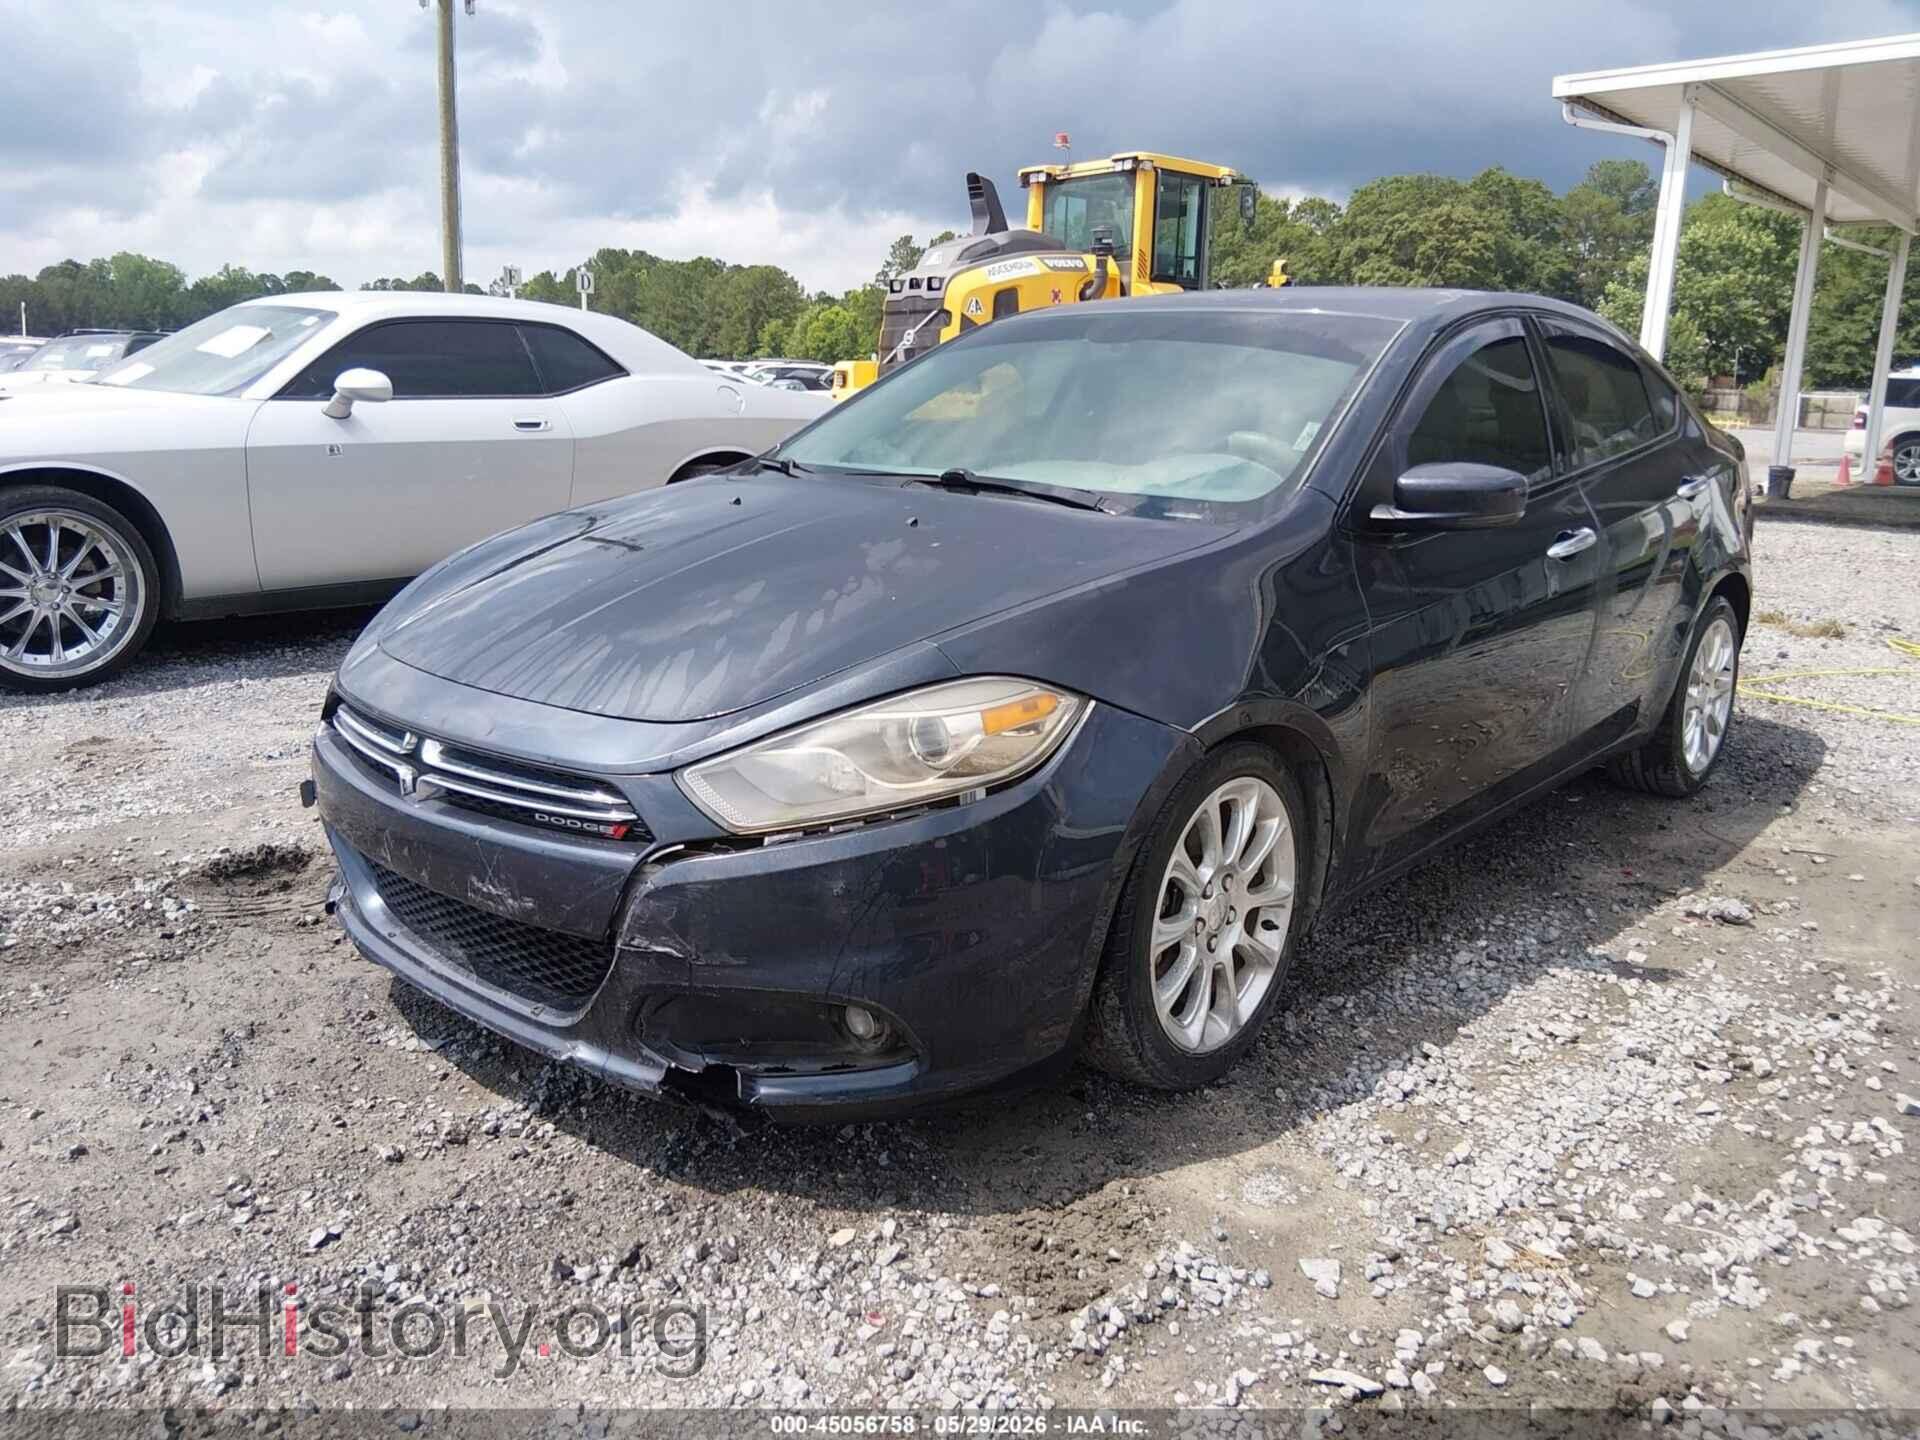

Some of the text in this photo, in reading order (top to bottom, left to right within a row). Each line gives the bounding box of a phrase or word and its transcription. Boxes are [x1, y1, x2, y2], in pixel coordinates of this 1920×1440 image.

[1044, 258, 1084, 268] VOLVO
[581, 273, 591, 291] D
[535, 813, 614, 834] DODGE
